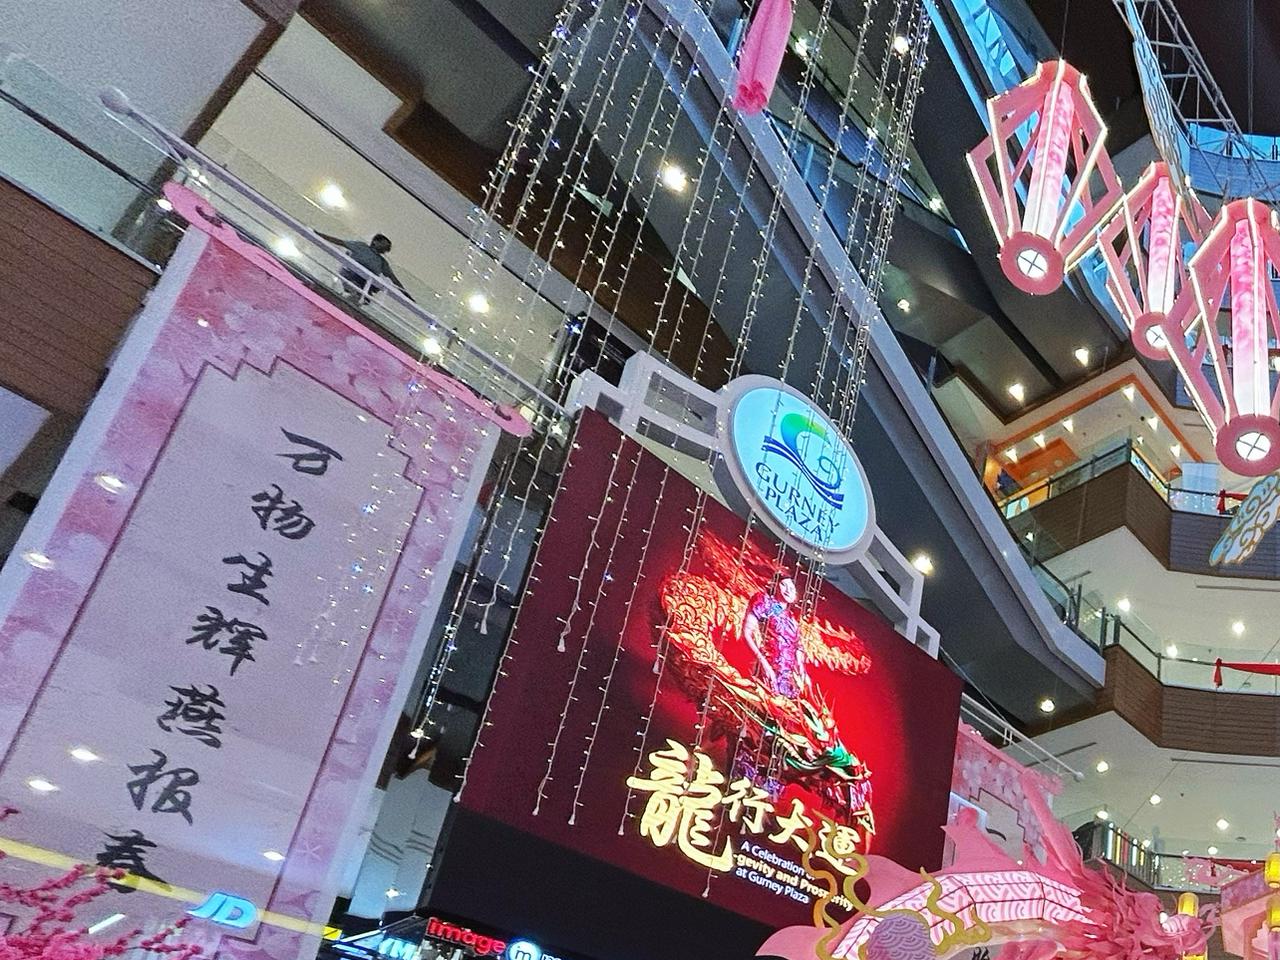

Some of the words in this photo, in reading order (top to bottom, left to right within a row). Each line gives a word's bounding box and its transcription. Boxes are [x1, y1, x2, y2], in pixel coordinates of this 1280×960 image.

[755, 461, 840, 534] GURNEY
[765, 486, 823, 542] PLAZA
[741, 841, 750, 852] A
[751, 845, 805, 876] Celebration
[735, 867, 748, 879] at
[748, 871, 784, 895] Gurney
[784, 886, 810, 904] Plaza
[776, 870, 799, 887] and
